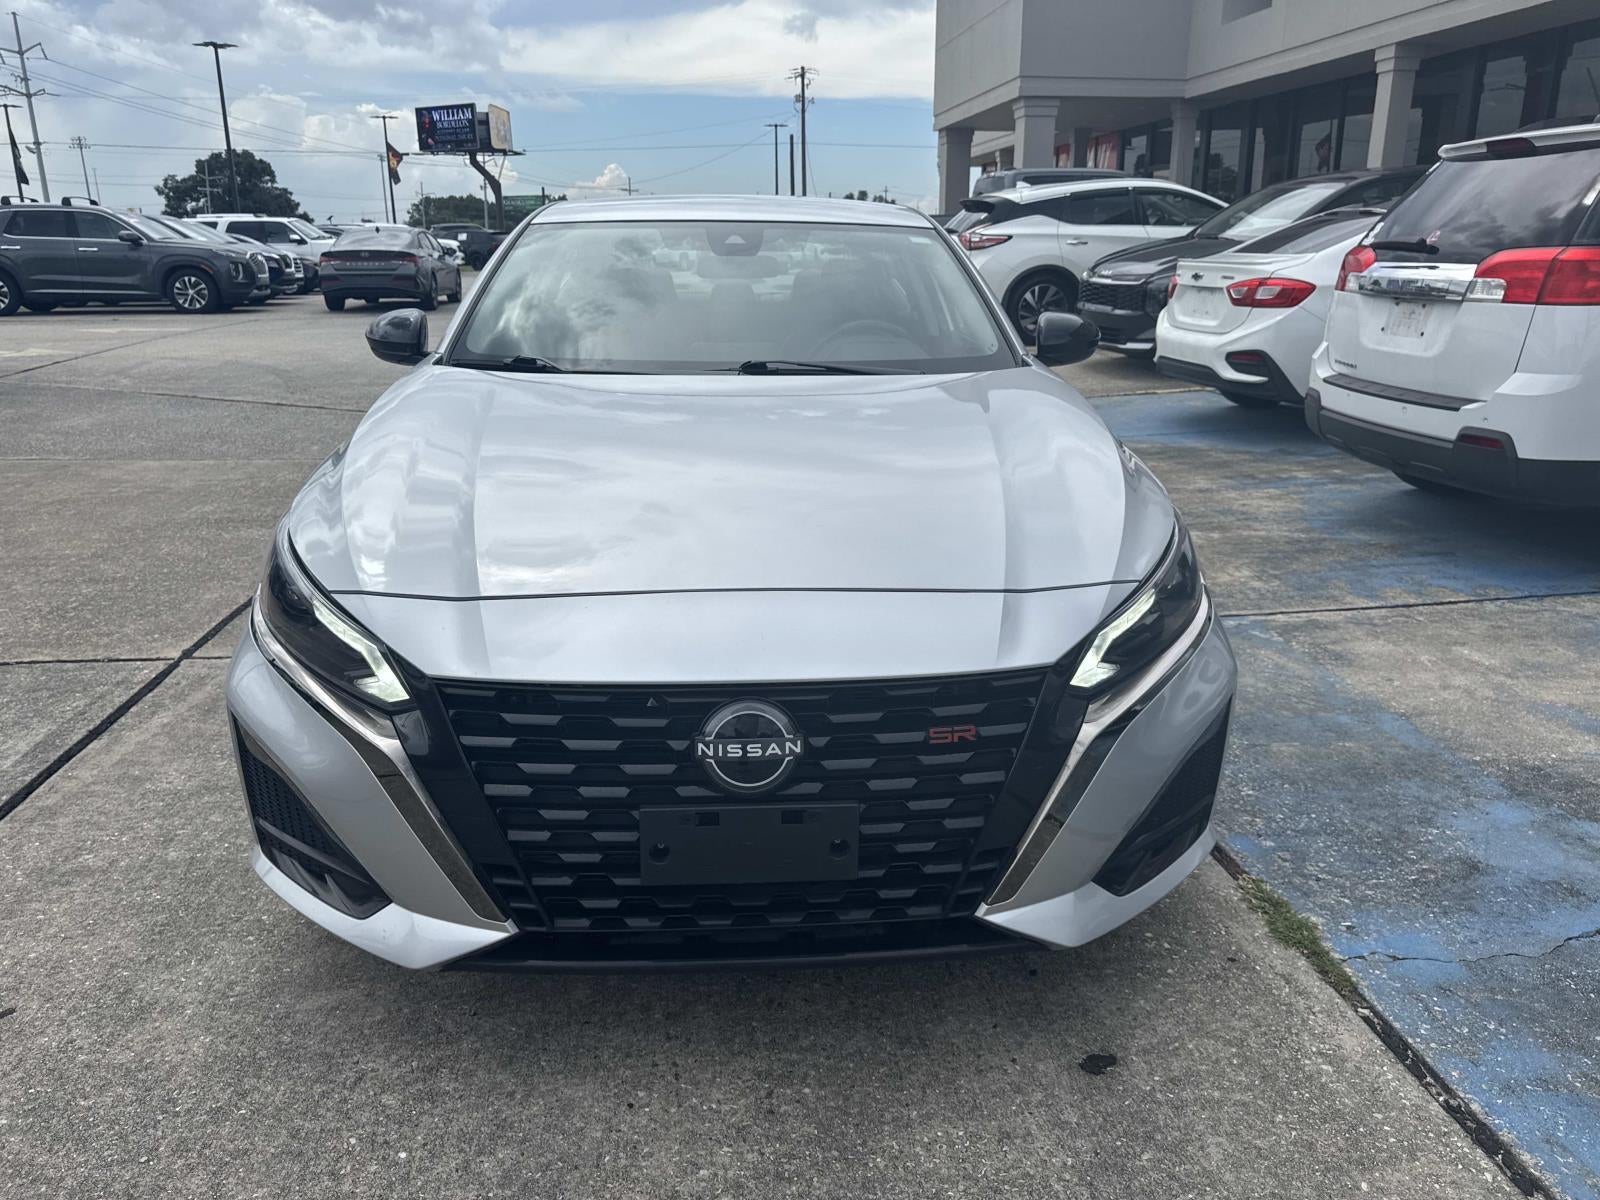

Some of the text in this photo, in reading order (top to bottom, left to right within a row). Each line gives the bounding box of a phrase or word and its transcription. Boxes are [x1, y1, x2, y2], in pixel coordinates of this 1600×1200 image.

[432, 108, 472, 121] WILLIAM
[928, 726, 977, 744] SR
[697, 740, 801, 757] NISSAN
